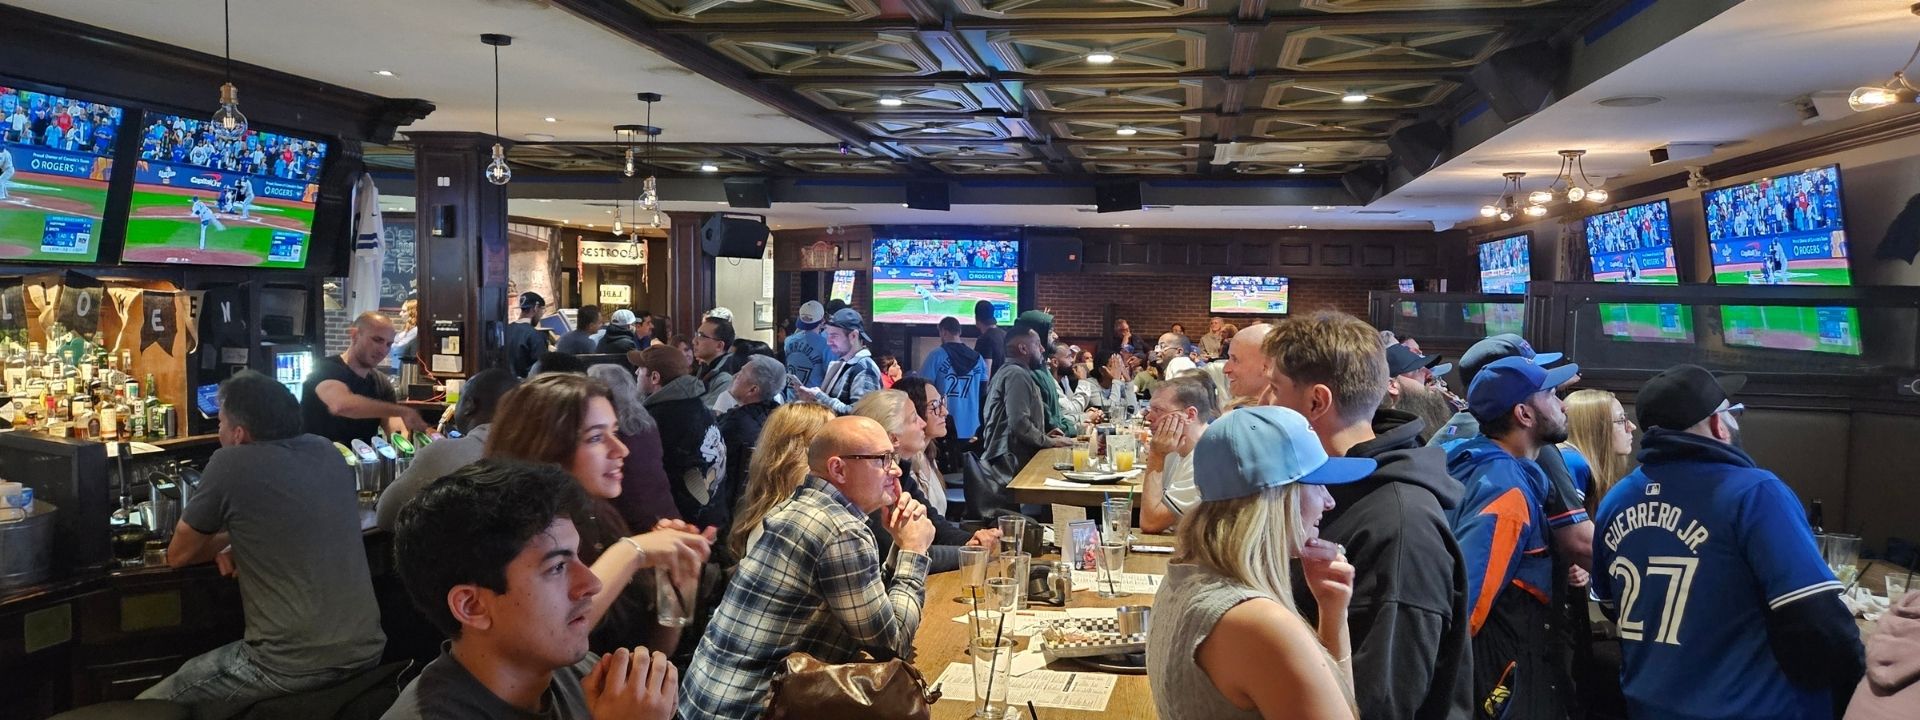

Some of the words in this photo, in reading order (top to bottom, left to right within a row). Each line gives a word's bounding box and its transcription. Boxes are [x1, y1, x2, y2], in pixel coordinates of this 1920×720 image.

[41, 161, 74, 172] ROGERS
[271, 187, 293, 196] ROGERS
[581, 247, 644, 259] RESTROOS
[1800, 244, 1820, 255] ROGERS
[945, 373, 974, 399] 27
[1604, 501, 1682, 552] GUERRERO
[1676, 519, 1709, 554] JR.
[1608, 556, 1700, 645] 27
